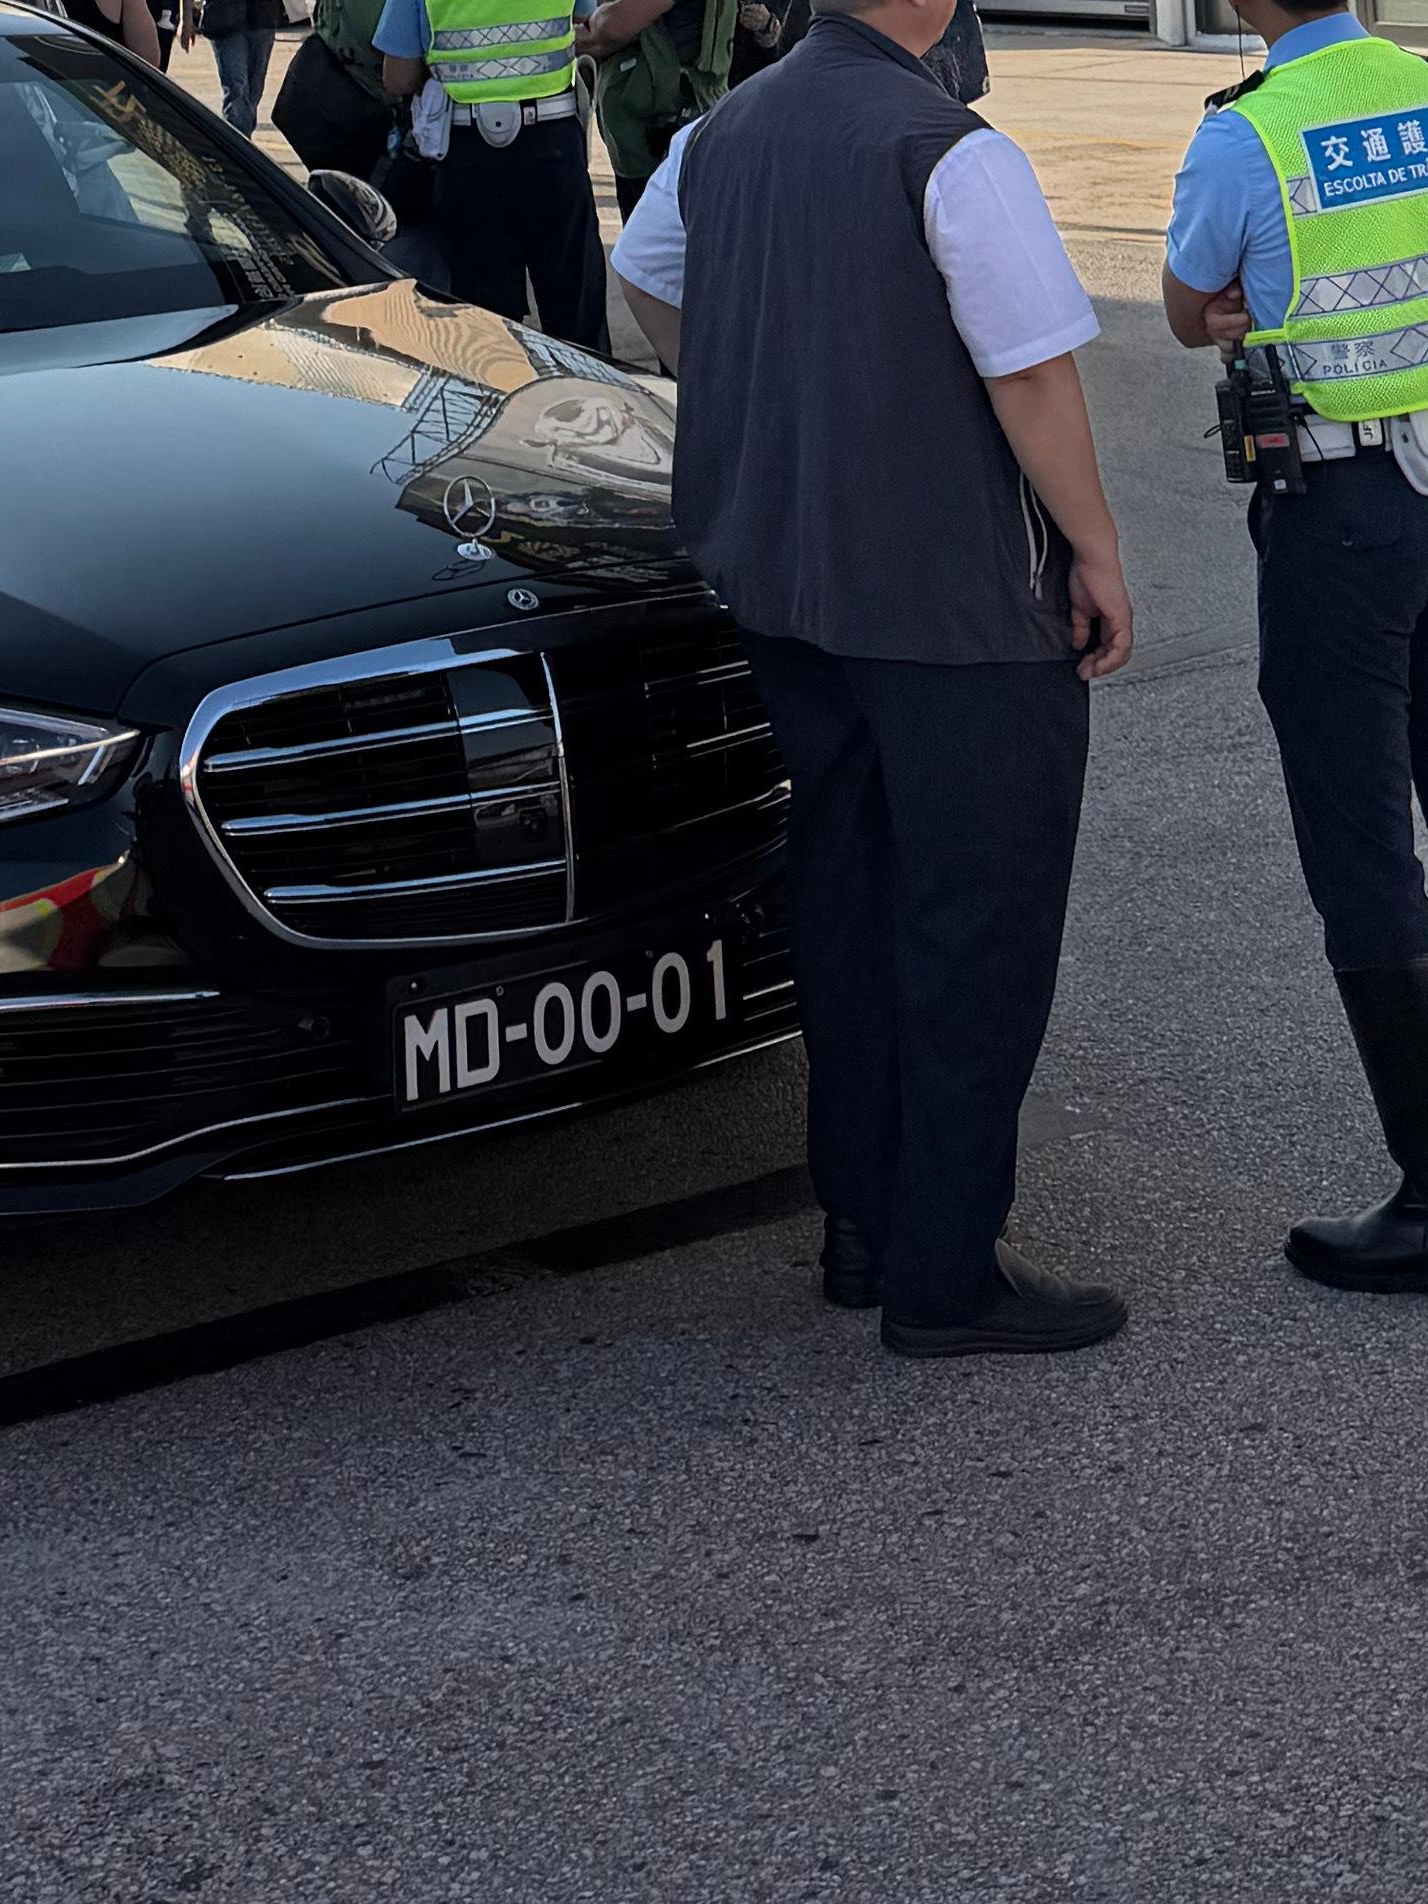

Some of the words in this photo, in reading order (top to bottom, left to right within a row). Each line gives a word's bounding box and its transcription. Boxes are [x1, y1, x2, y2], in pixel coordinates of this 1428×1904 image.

[1323, 170, 1386, 199] ESCOLTA
[1388, 168, 1405, 187] DE
[404, 939, 727, 1101] MD-00-01
